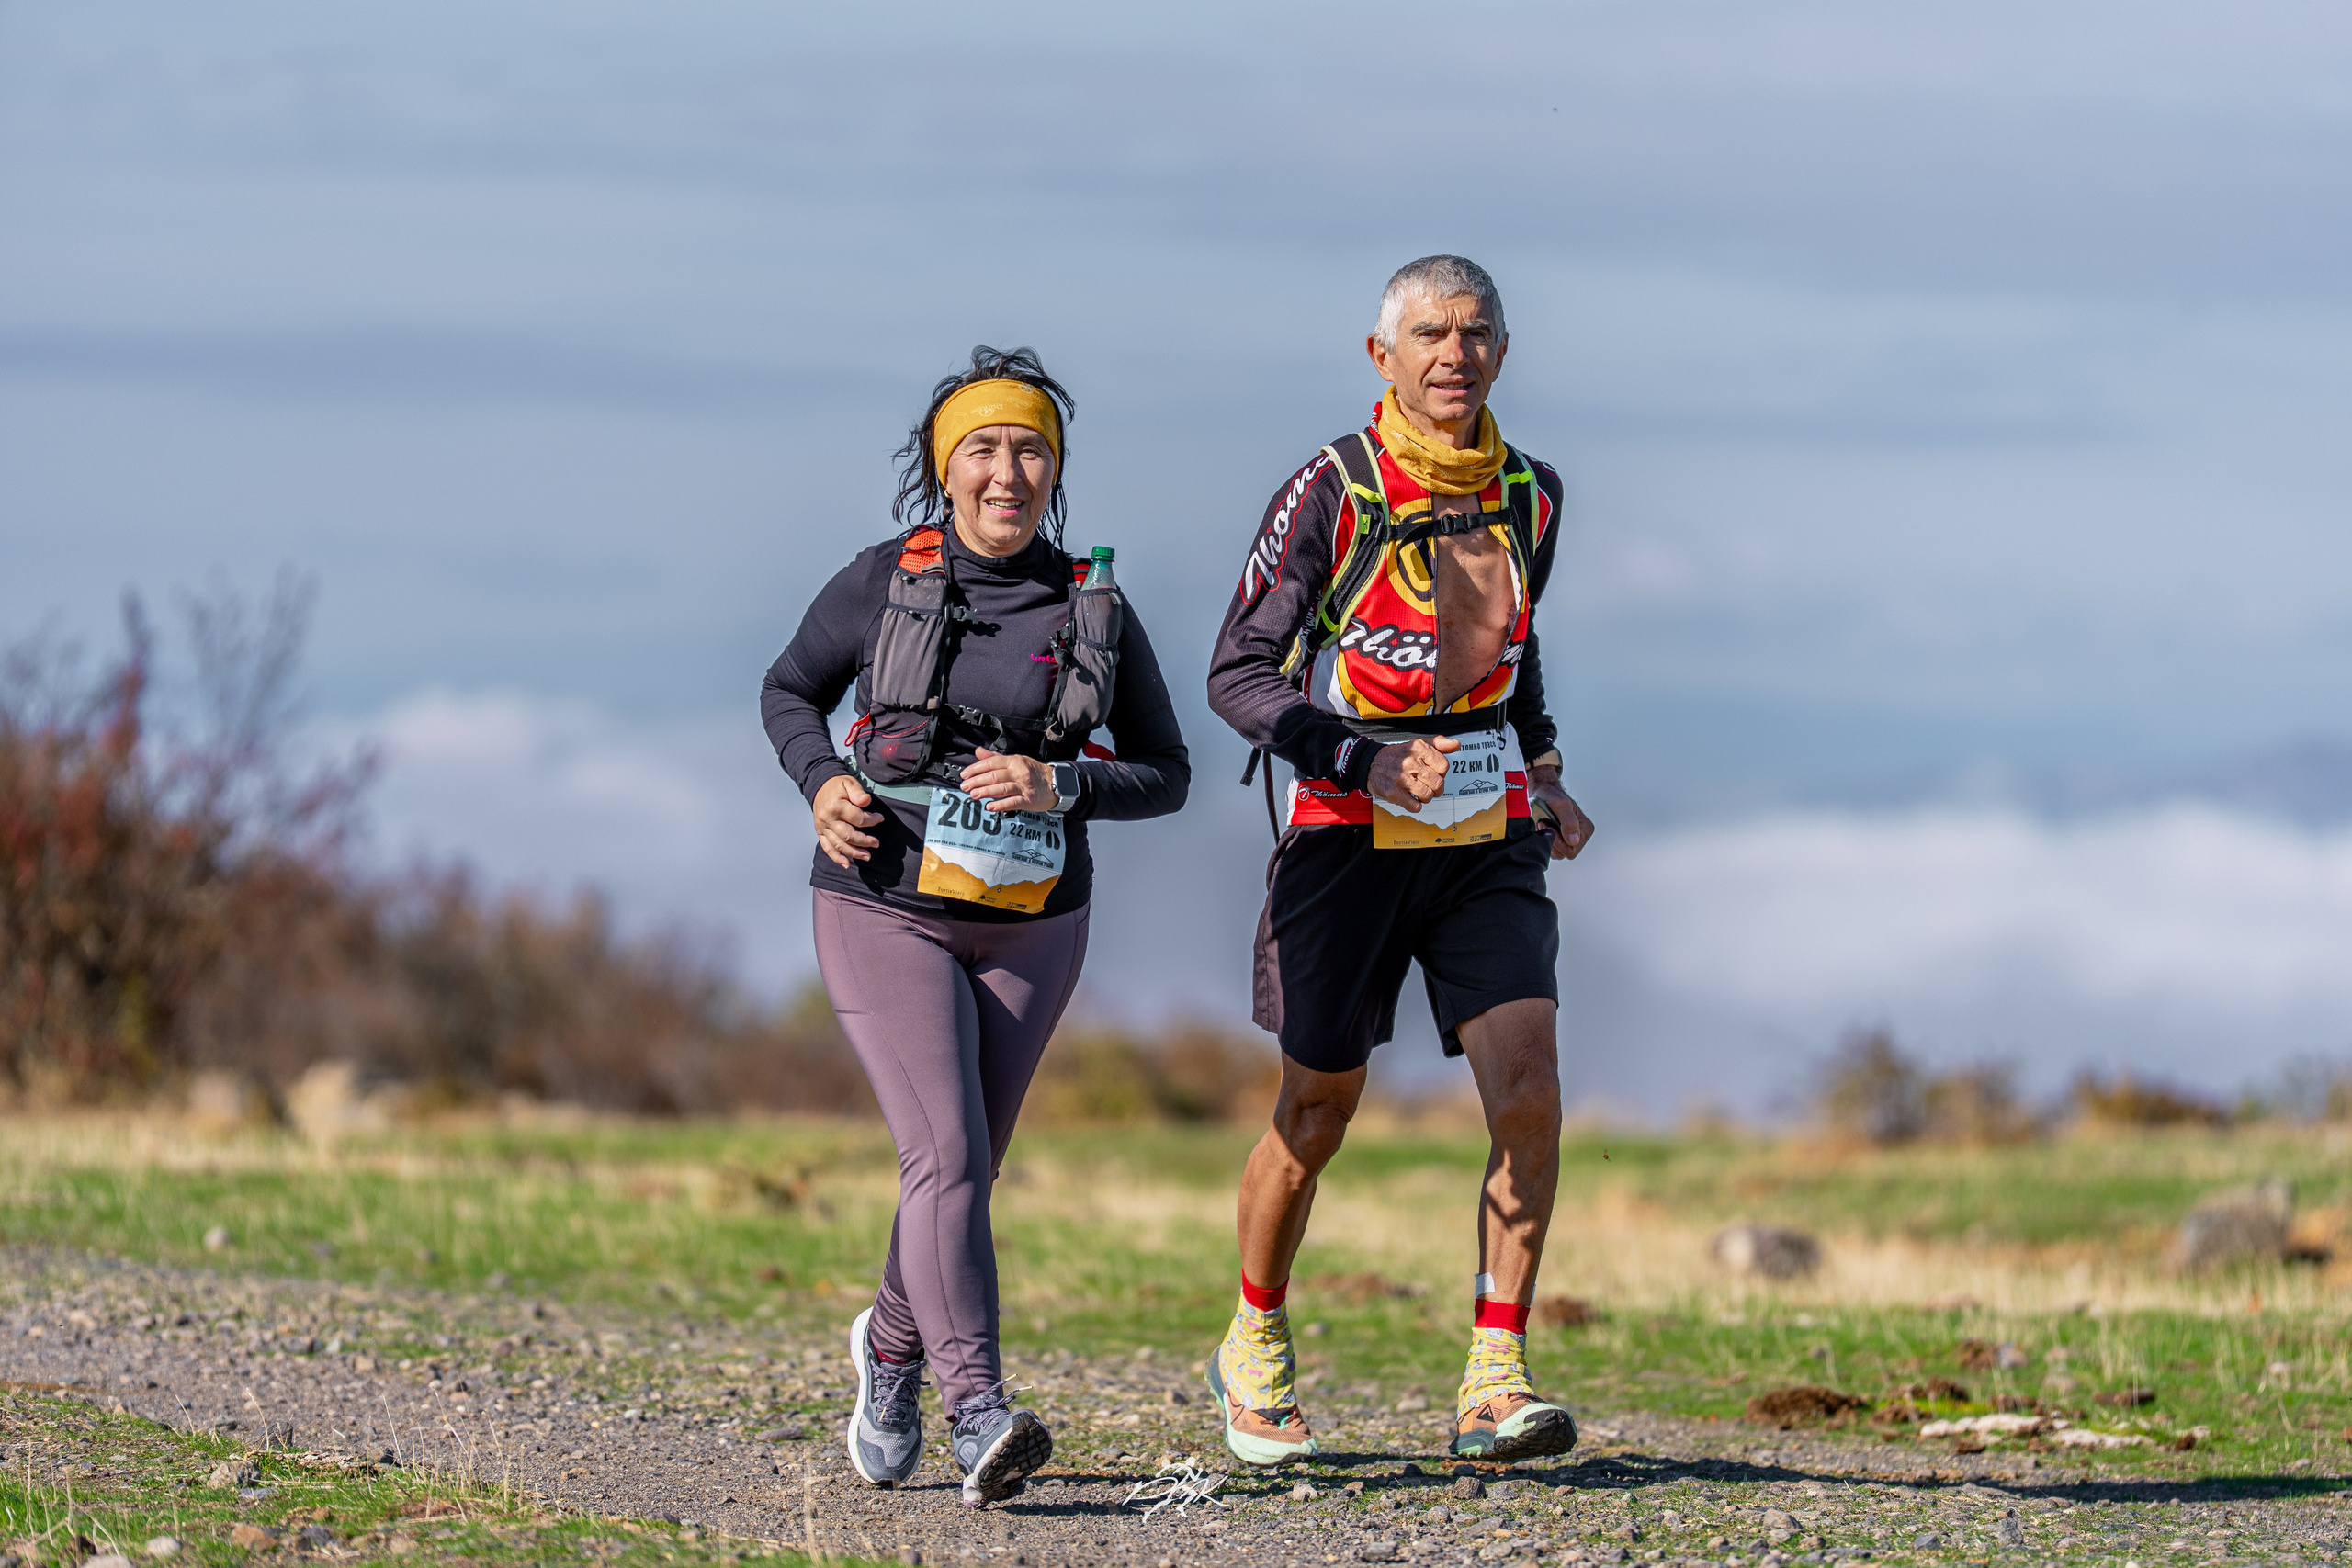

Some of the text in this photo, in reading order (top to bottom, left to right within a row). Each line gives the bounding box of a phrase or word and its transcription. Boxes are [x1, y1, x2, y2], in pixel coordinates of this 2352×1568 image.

[1453, 761, 1466, 773] 22
[937, 793, 1002, 836] 203
[1010, 822, 1023, 838] 22
